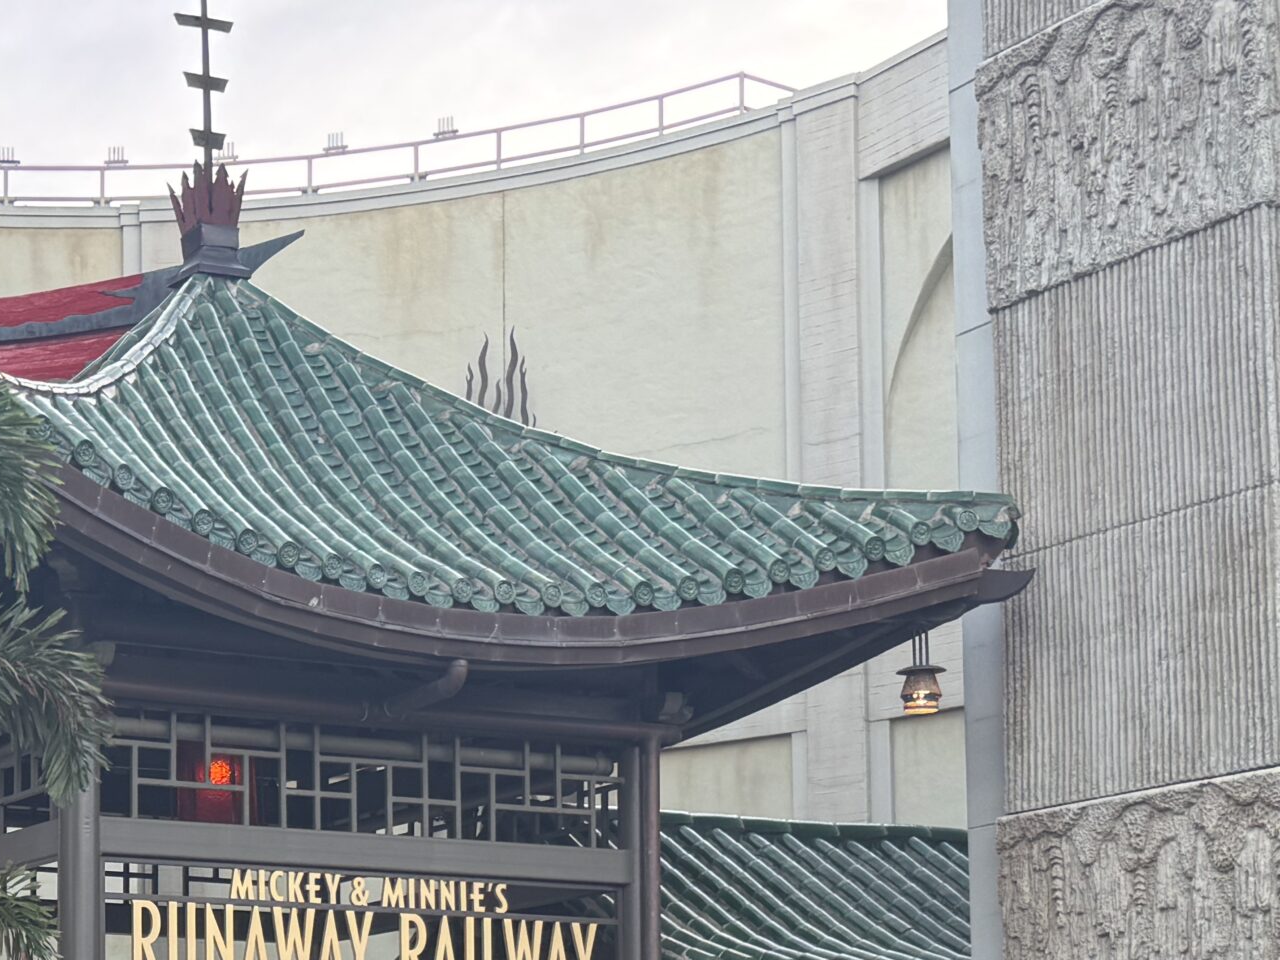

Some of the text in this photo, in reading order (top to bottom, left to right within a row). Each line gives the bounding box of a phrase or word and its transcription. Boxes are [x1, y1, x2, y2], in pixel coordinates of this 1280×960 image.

[230, 869, 509, 914] MICKEY & MINNIE'S
